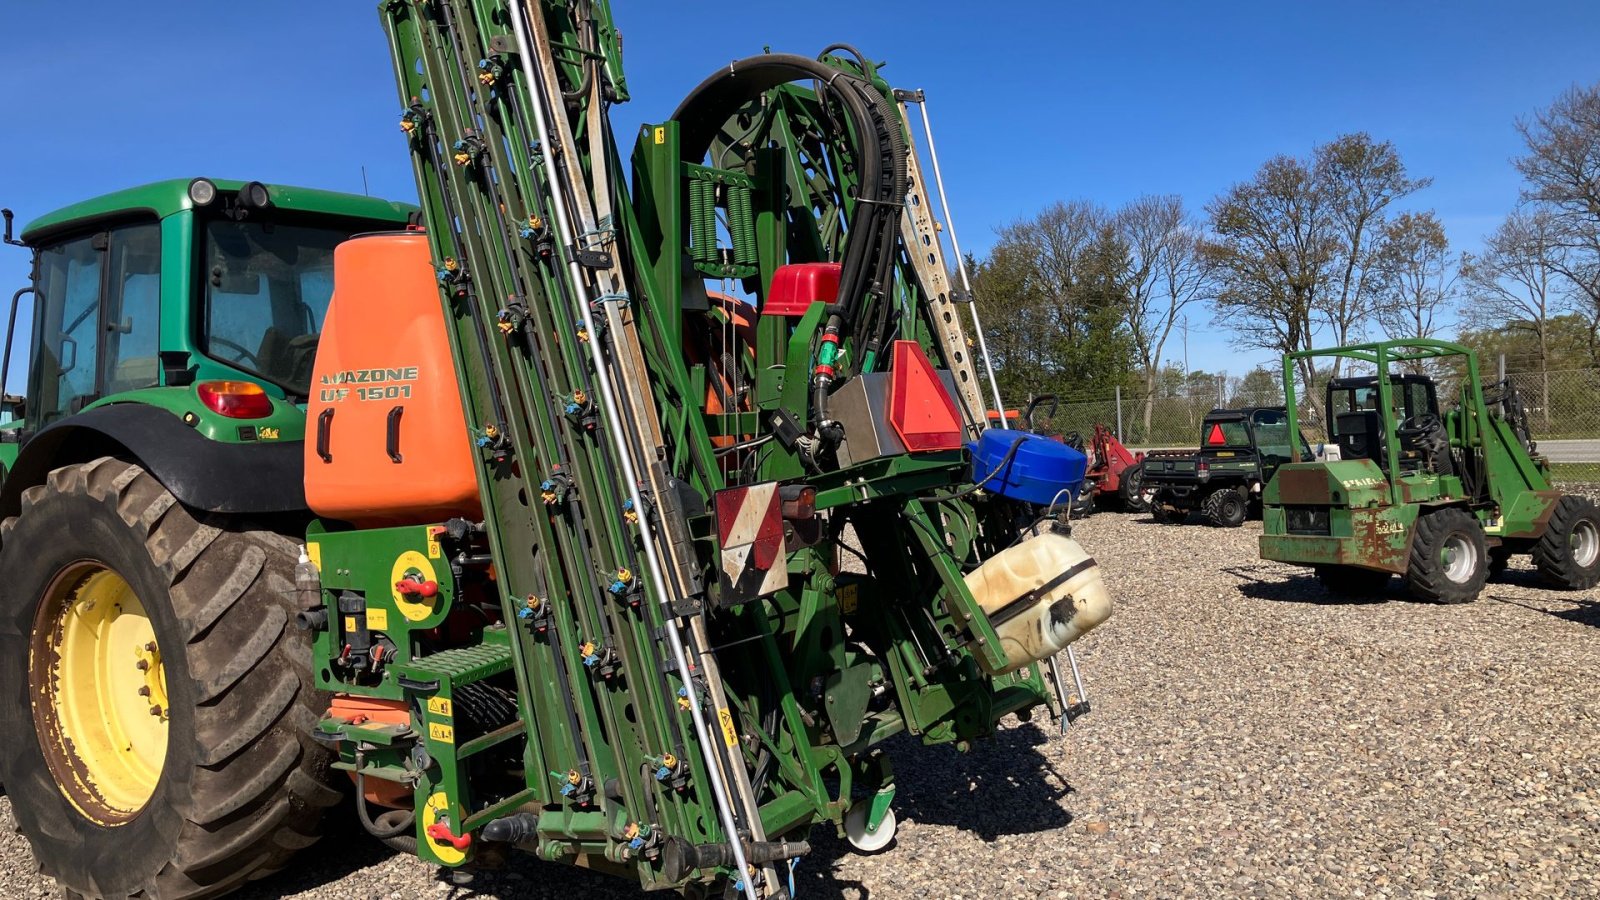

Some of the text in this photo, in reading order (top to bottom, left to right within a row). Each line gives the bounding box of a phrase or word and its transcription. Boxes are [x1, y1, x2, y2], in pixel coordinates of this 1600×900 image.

[320, 366, 419, 385] AMAZONE
[320, 384, 412, 402] UF 1501
